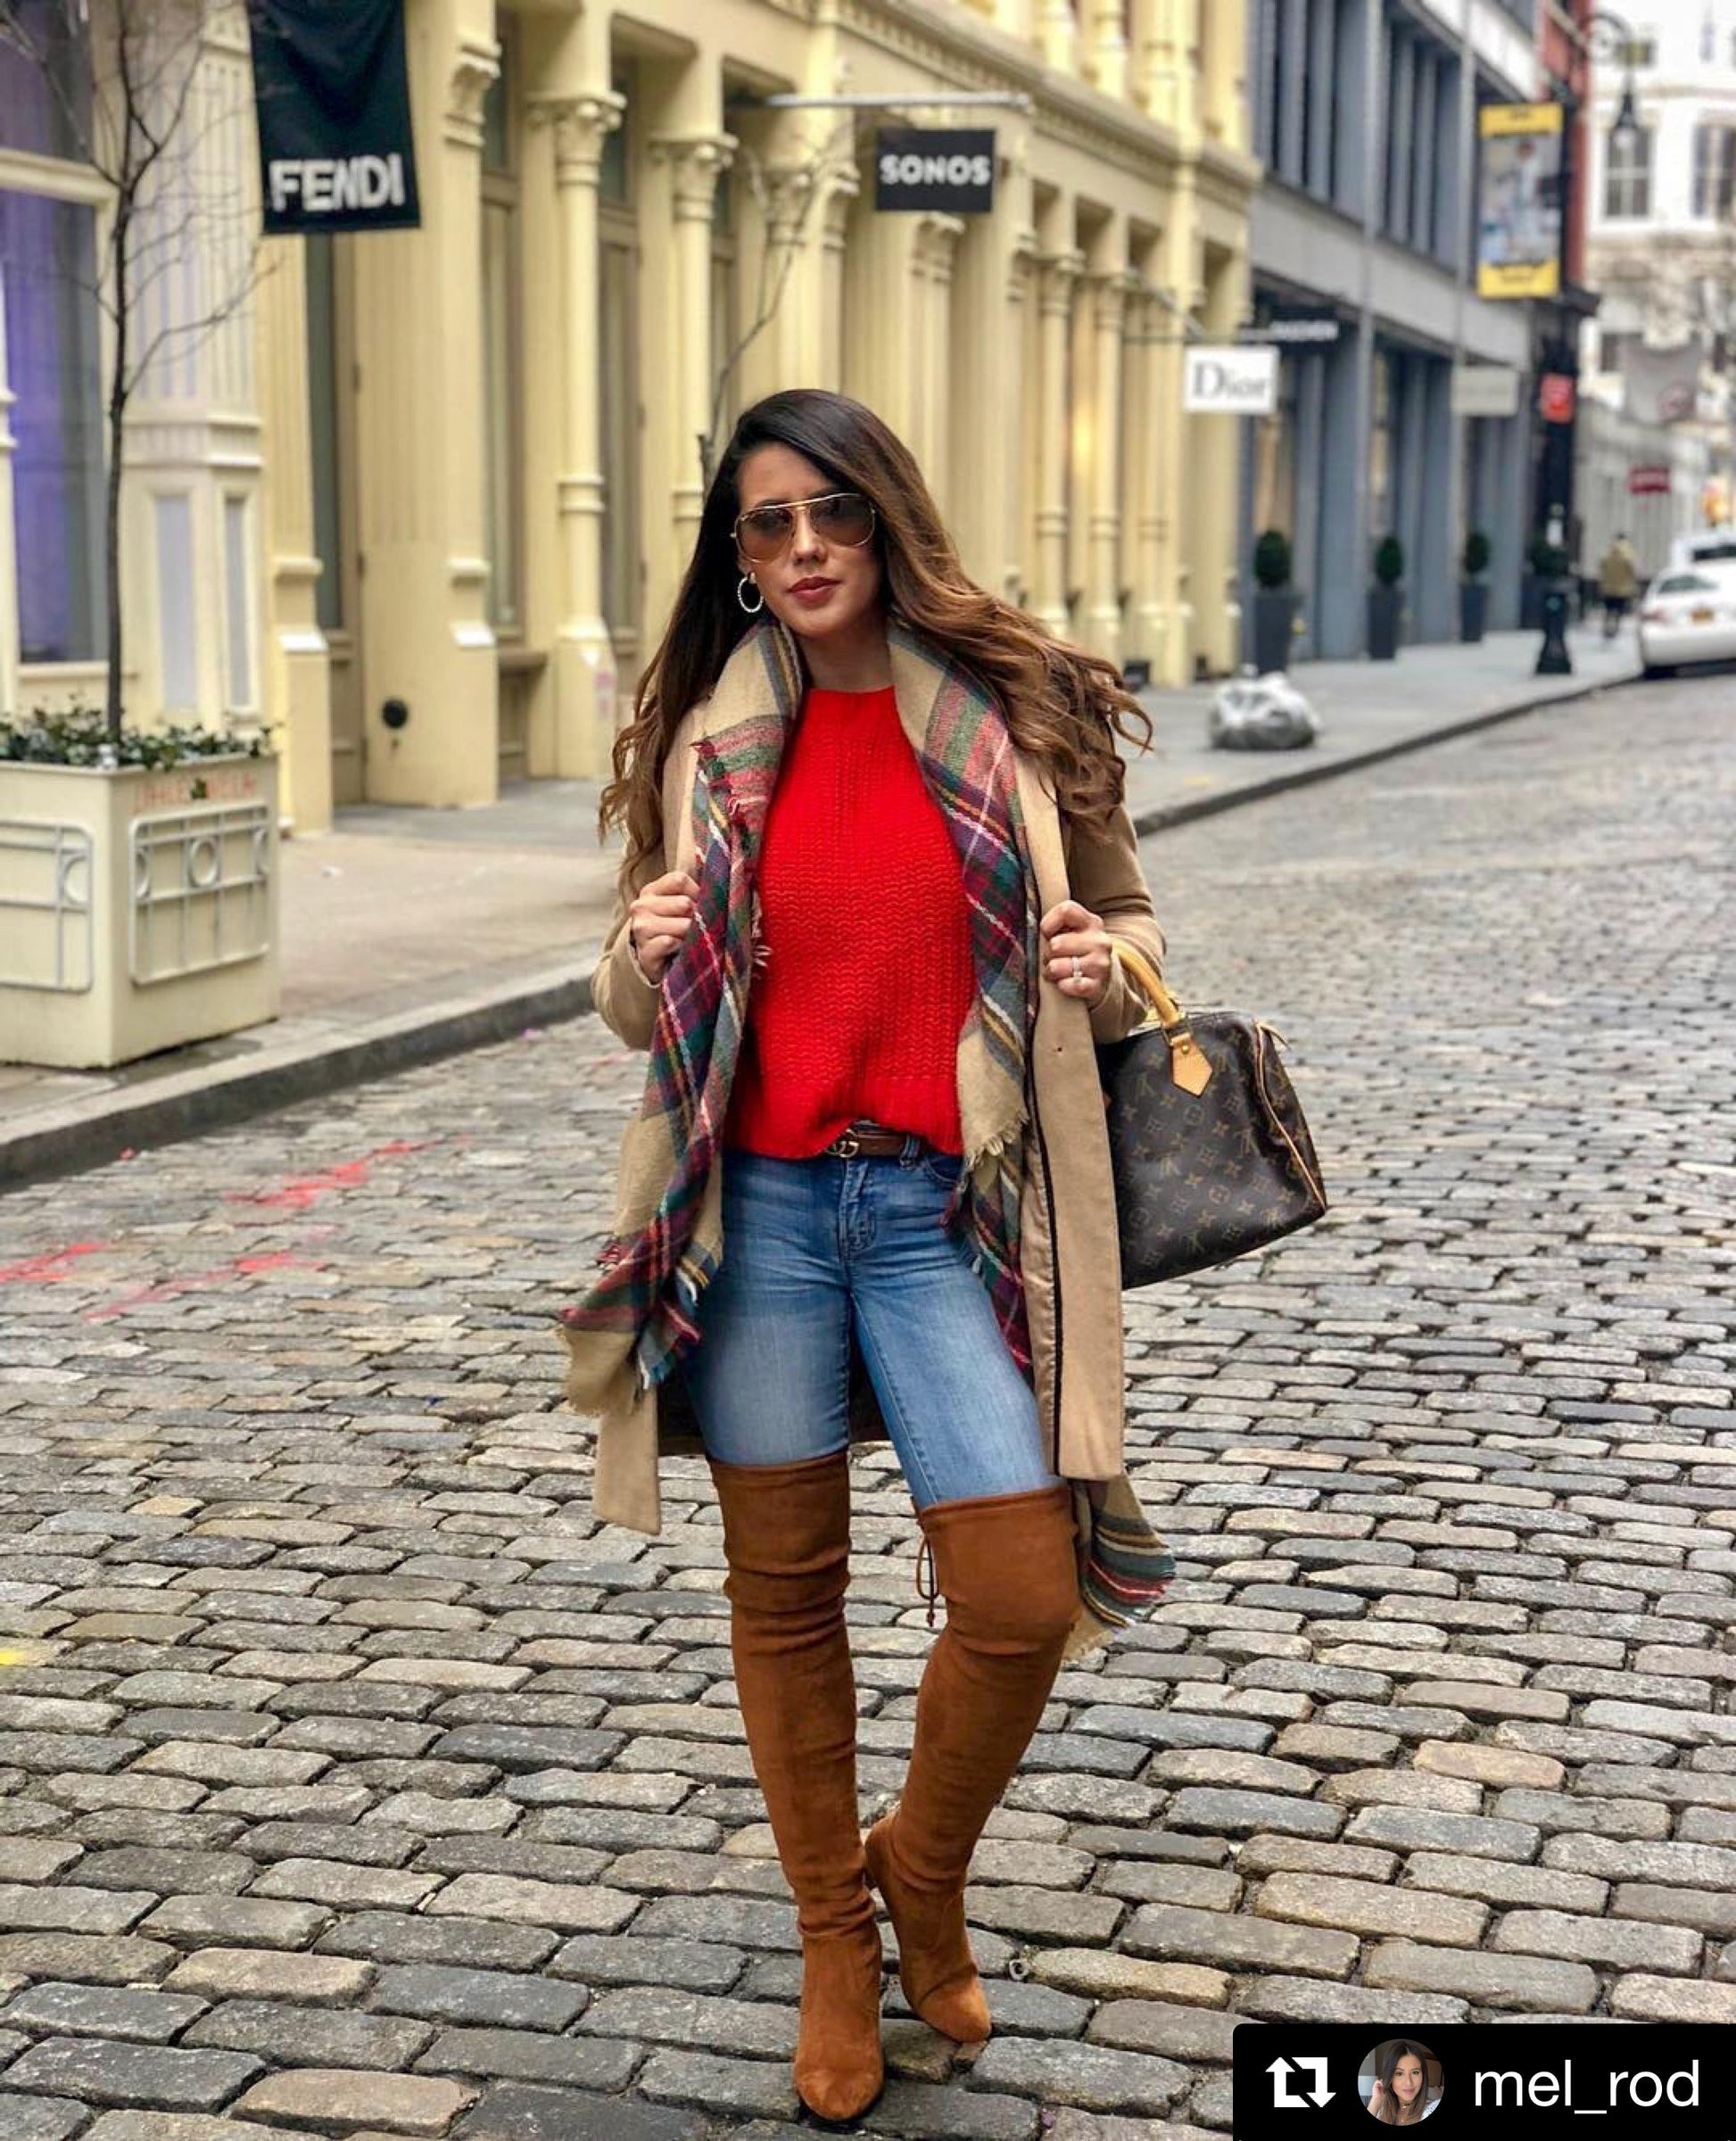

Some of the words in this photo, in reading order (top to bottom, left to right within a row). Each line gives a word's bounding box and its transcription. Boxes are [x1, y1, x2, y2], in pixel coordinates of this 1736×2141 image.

[269, 153, 405, 212] FENDI
[880, 153, 991, 186] SONOS
[1193, 360, 1267, 399] Dior
